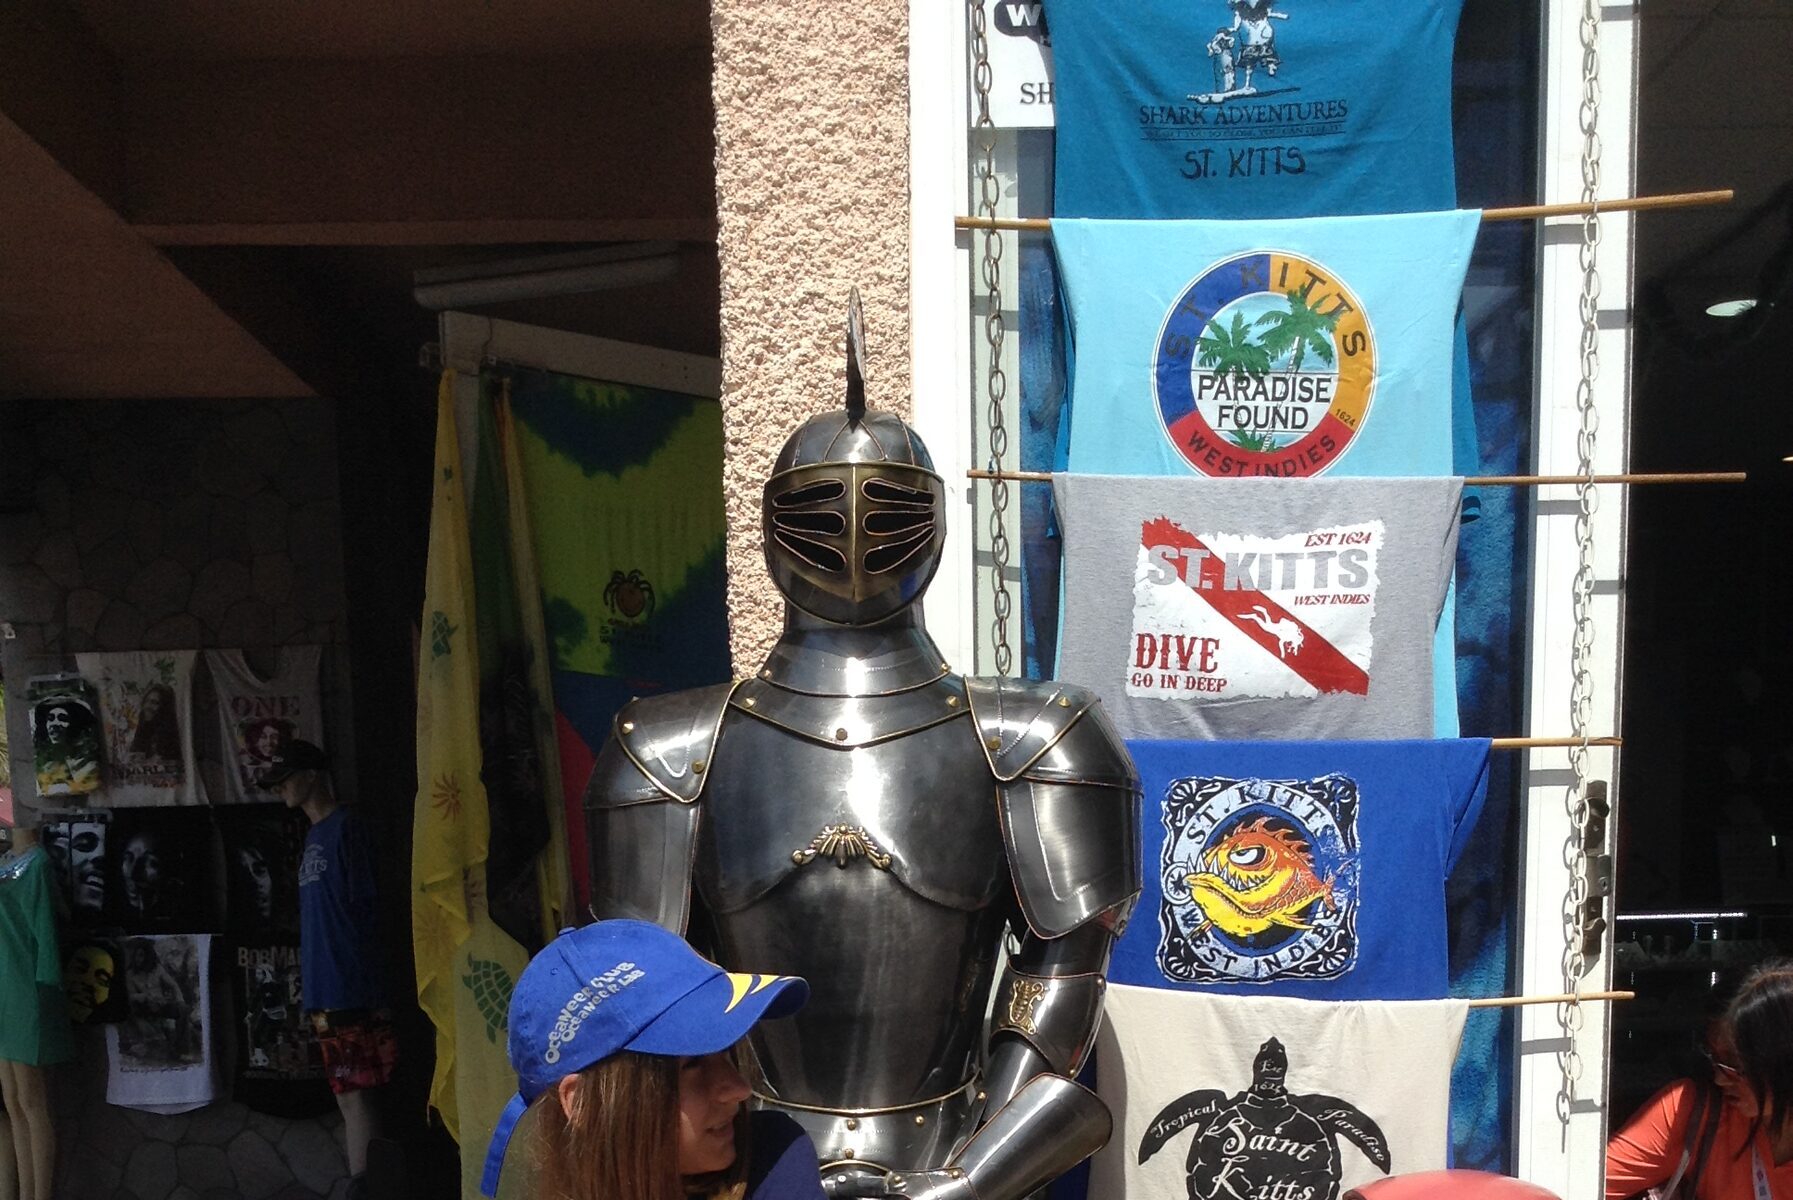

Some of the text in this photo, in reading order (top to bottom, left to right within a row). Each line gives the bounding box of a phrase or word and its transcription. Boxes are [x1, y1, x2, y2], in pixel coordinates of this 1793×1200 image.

[1140, 100, 1348, 125] SHARK ADVENTURES
[1180, 145, 1307, 179] ST. KITTS
[1240, 262, 1367, 358] KITTS
[1197, 374, 1332, 403] PARADISE
[1217, 405, 1309, 430] FOUND
[1335, 408, 1356, 427] 1624
[1187, 430, 1336, 478] WEST INDIES
[1304, 531, 1373, 548] EST 1624
[1147, 544, 1370, 592] ST. KITTS
[1294, 594, 1371, 606] WEST INDIES
[1134, 633, 1221, 674] DIVE
[1131, 672, 1228, 693] GO IN DEEP
[1186, 805, 1231, 845] ST.
[1180, 909, 1239, 971] WEST
[1149, 1099, 1217, 1139] Tropical
[1205, 1115, 1318, 1162] Saint
[1316, 1107, 1386, 1162] Paradise
